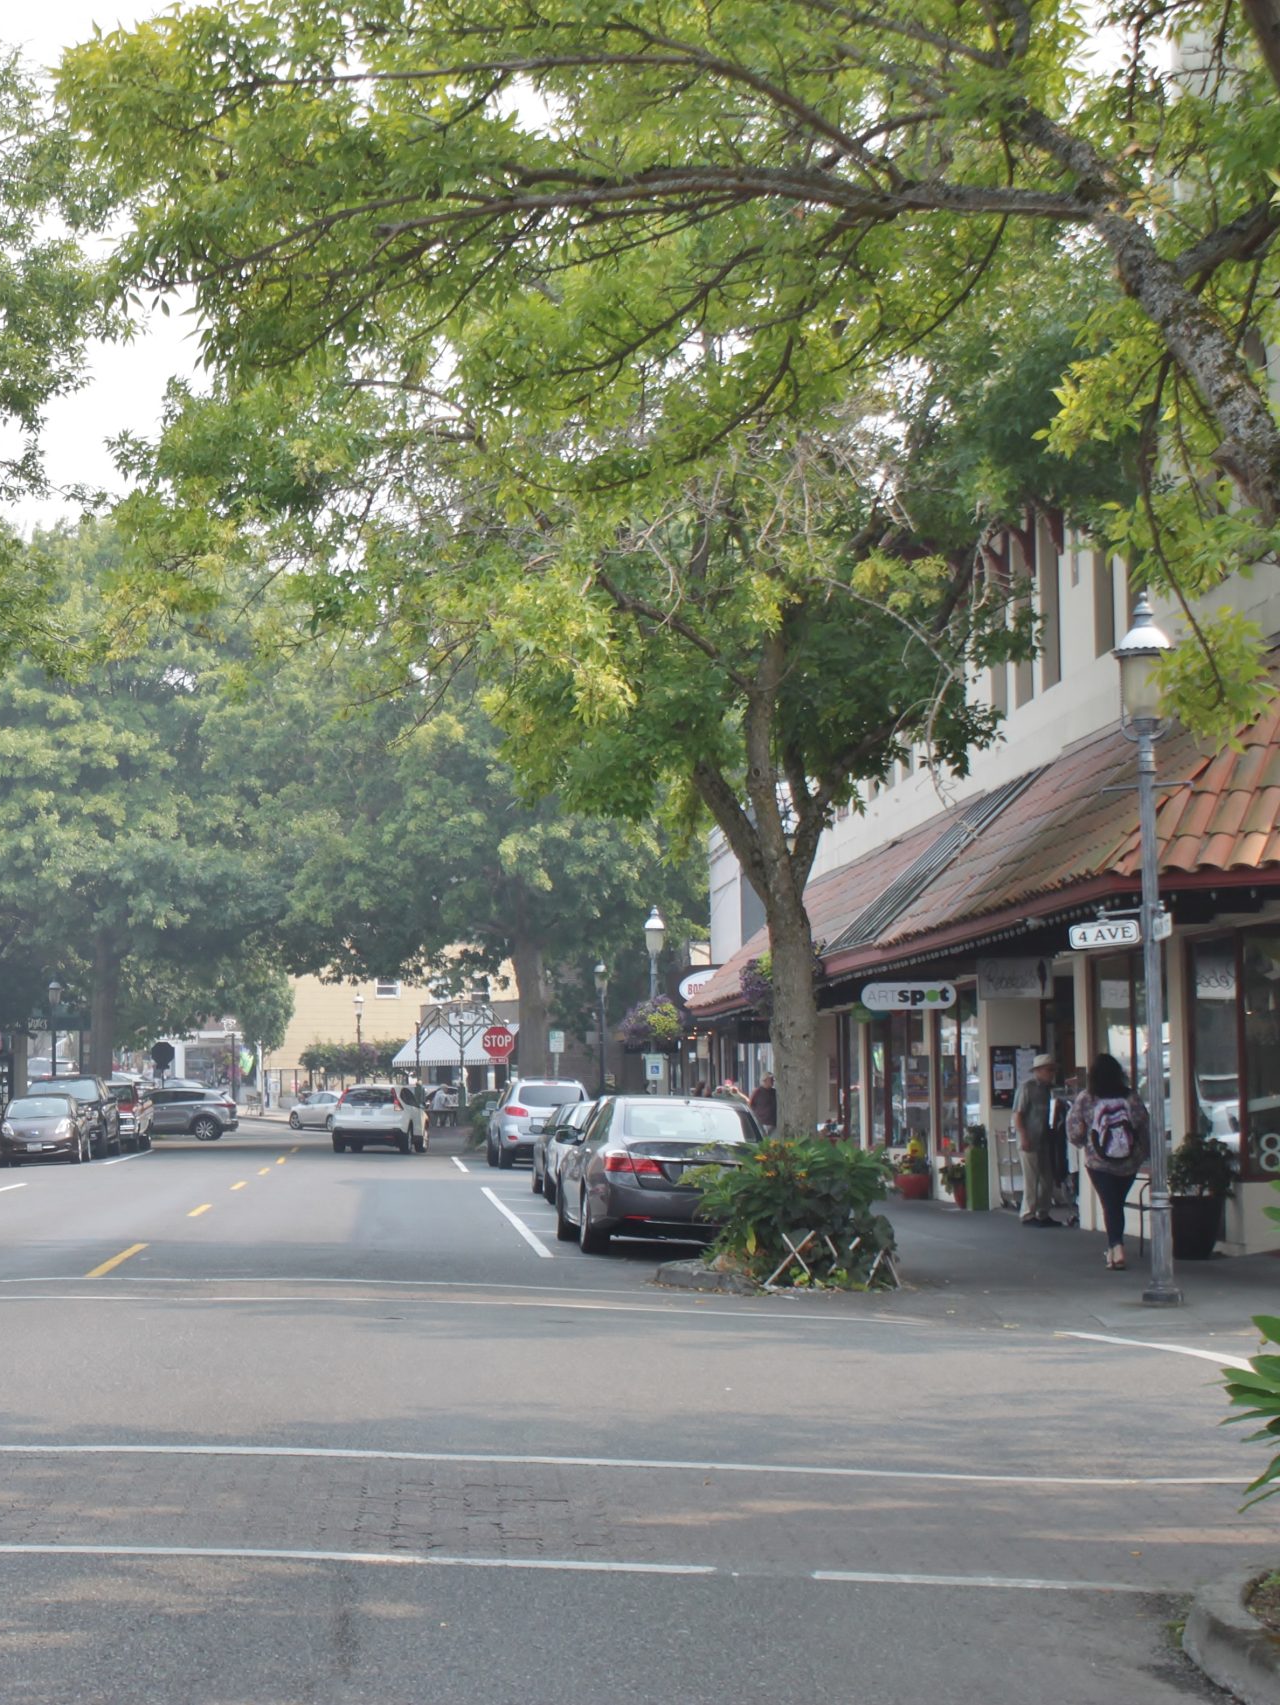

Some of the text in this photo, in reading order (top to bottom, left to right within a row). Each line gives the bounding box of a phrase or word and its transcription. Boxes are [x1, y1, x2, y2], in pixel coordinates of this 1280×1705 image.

[1078, 926, 1133, 942] 4 AVE
[484, 1035, 512, 1048] STOP
